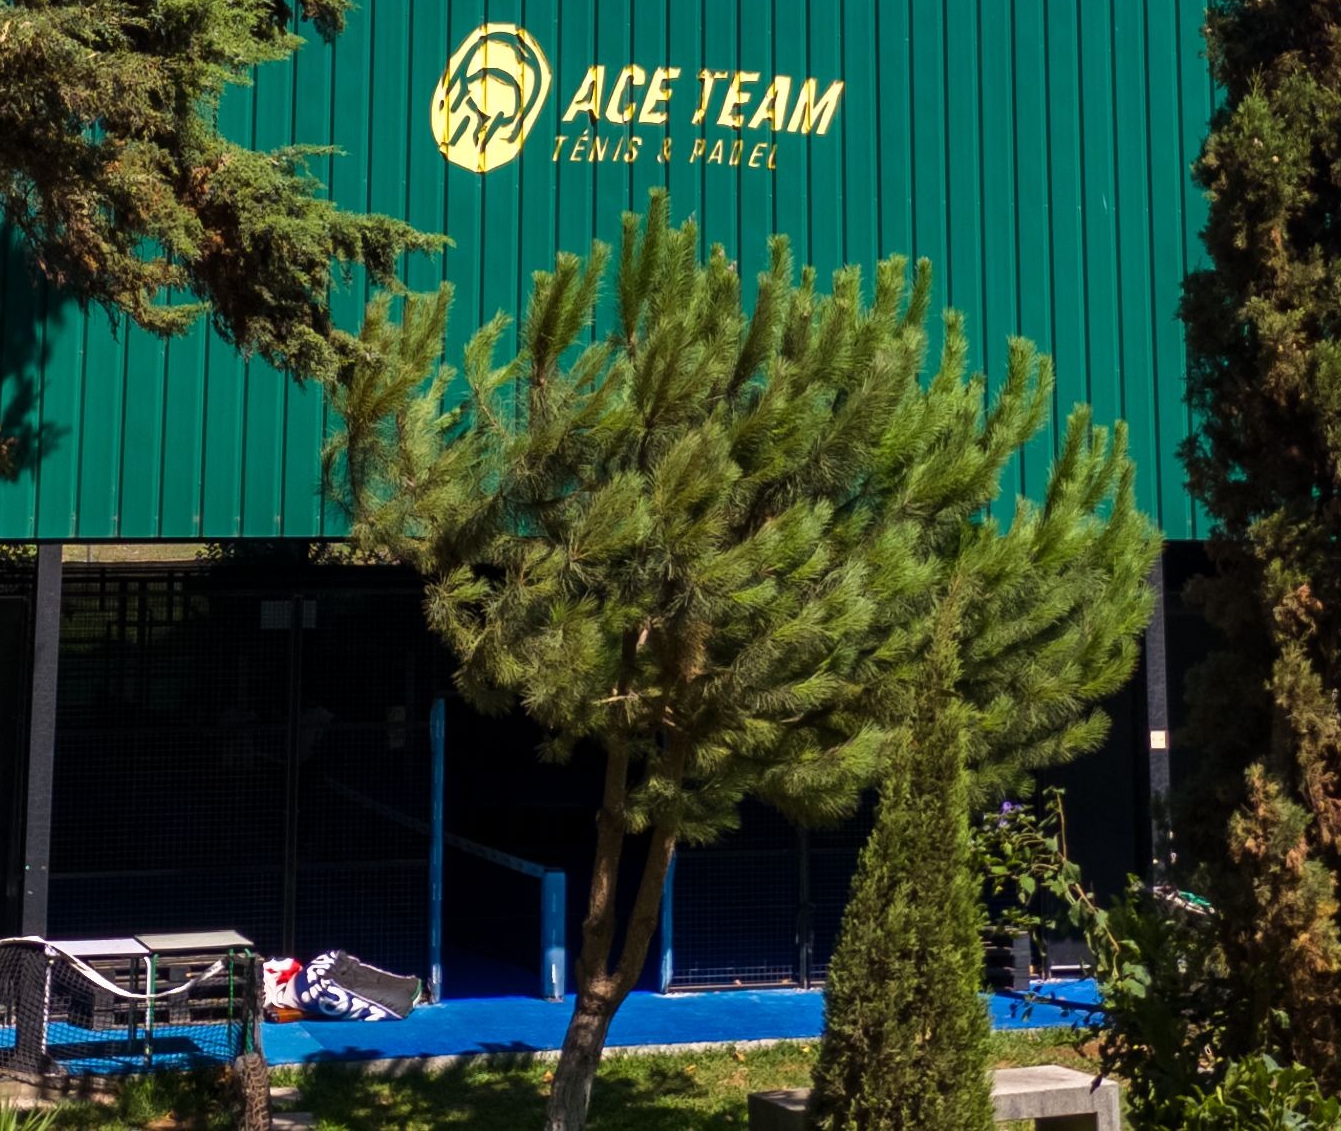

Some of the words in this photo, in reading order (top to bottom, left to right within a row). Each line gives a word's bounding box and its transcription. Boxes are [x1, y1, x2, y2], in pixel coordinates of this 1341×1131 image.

[562, 64, 681, 124] ACE
[692, 68, 845, 135] TEAM
[552, 130, 642, 162] TÉNIS
[657, 136, 672, 164] &
[690, 137, 778, 169] PADEL
